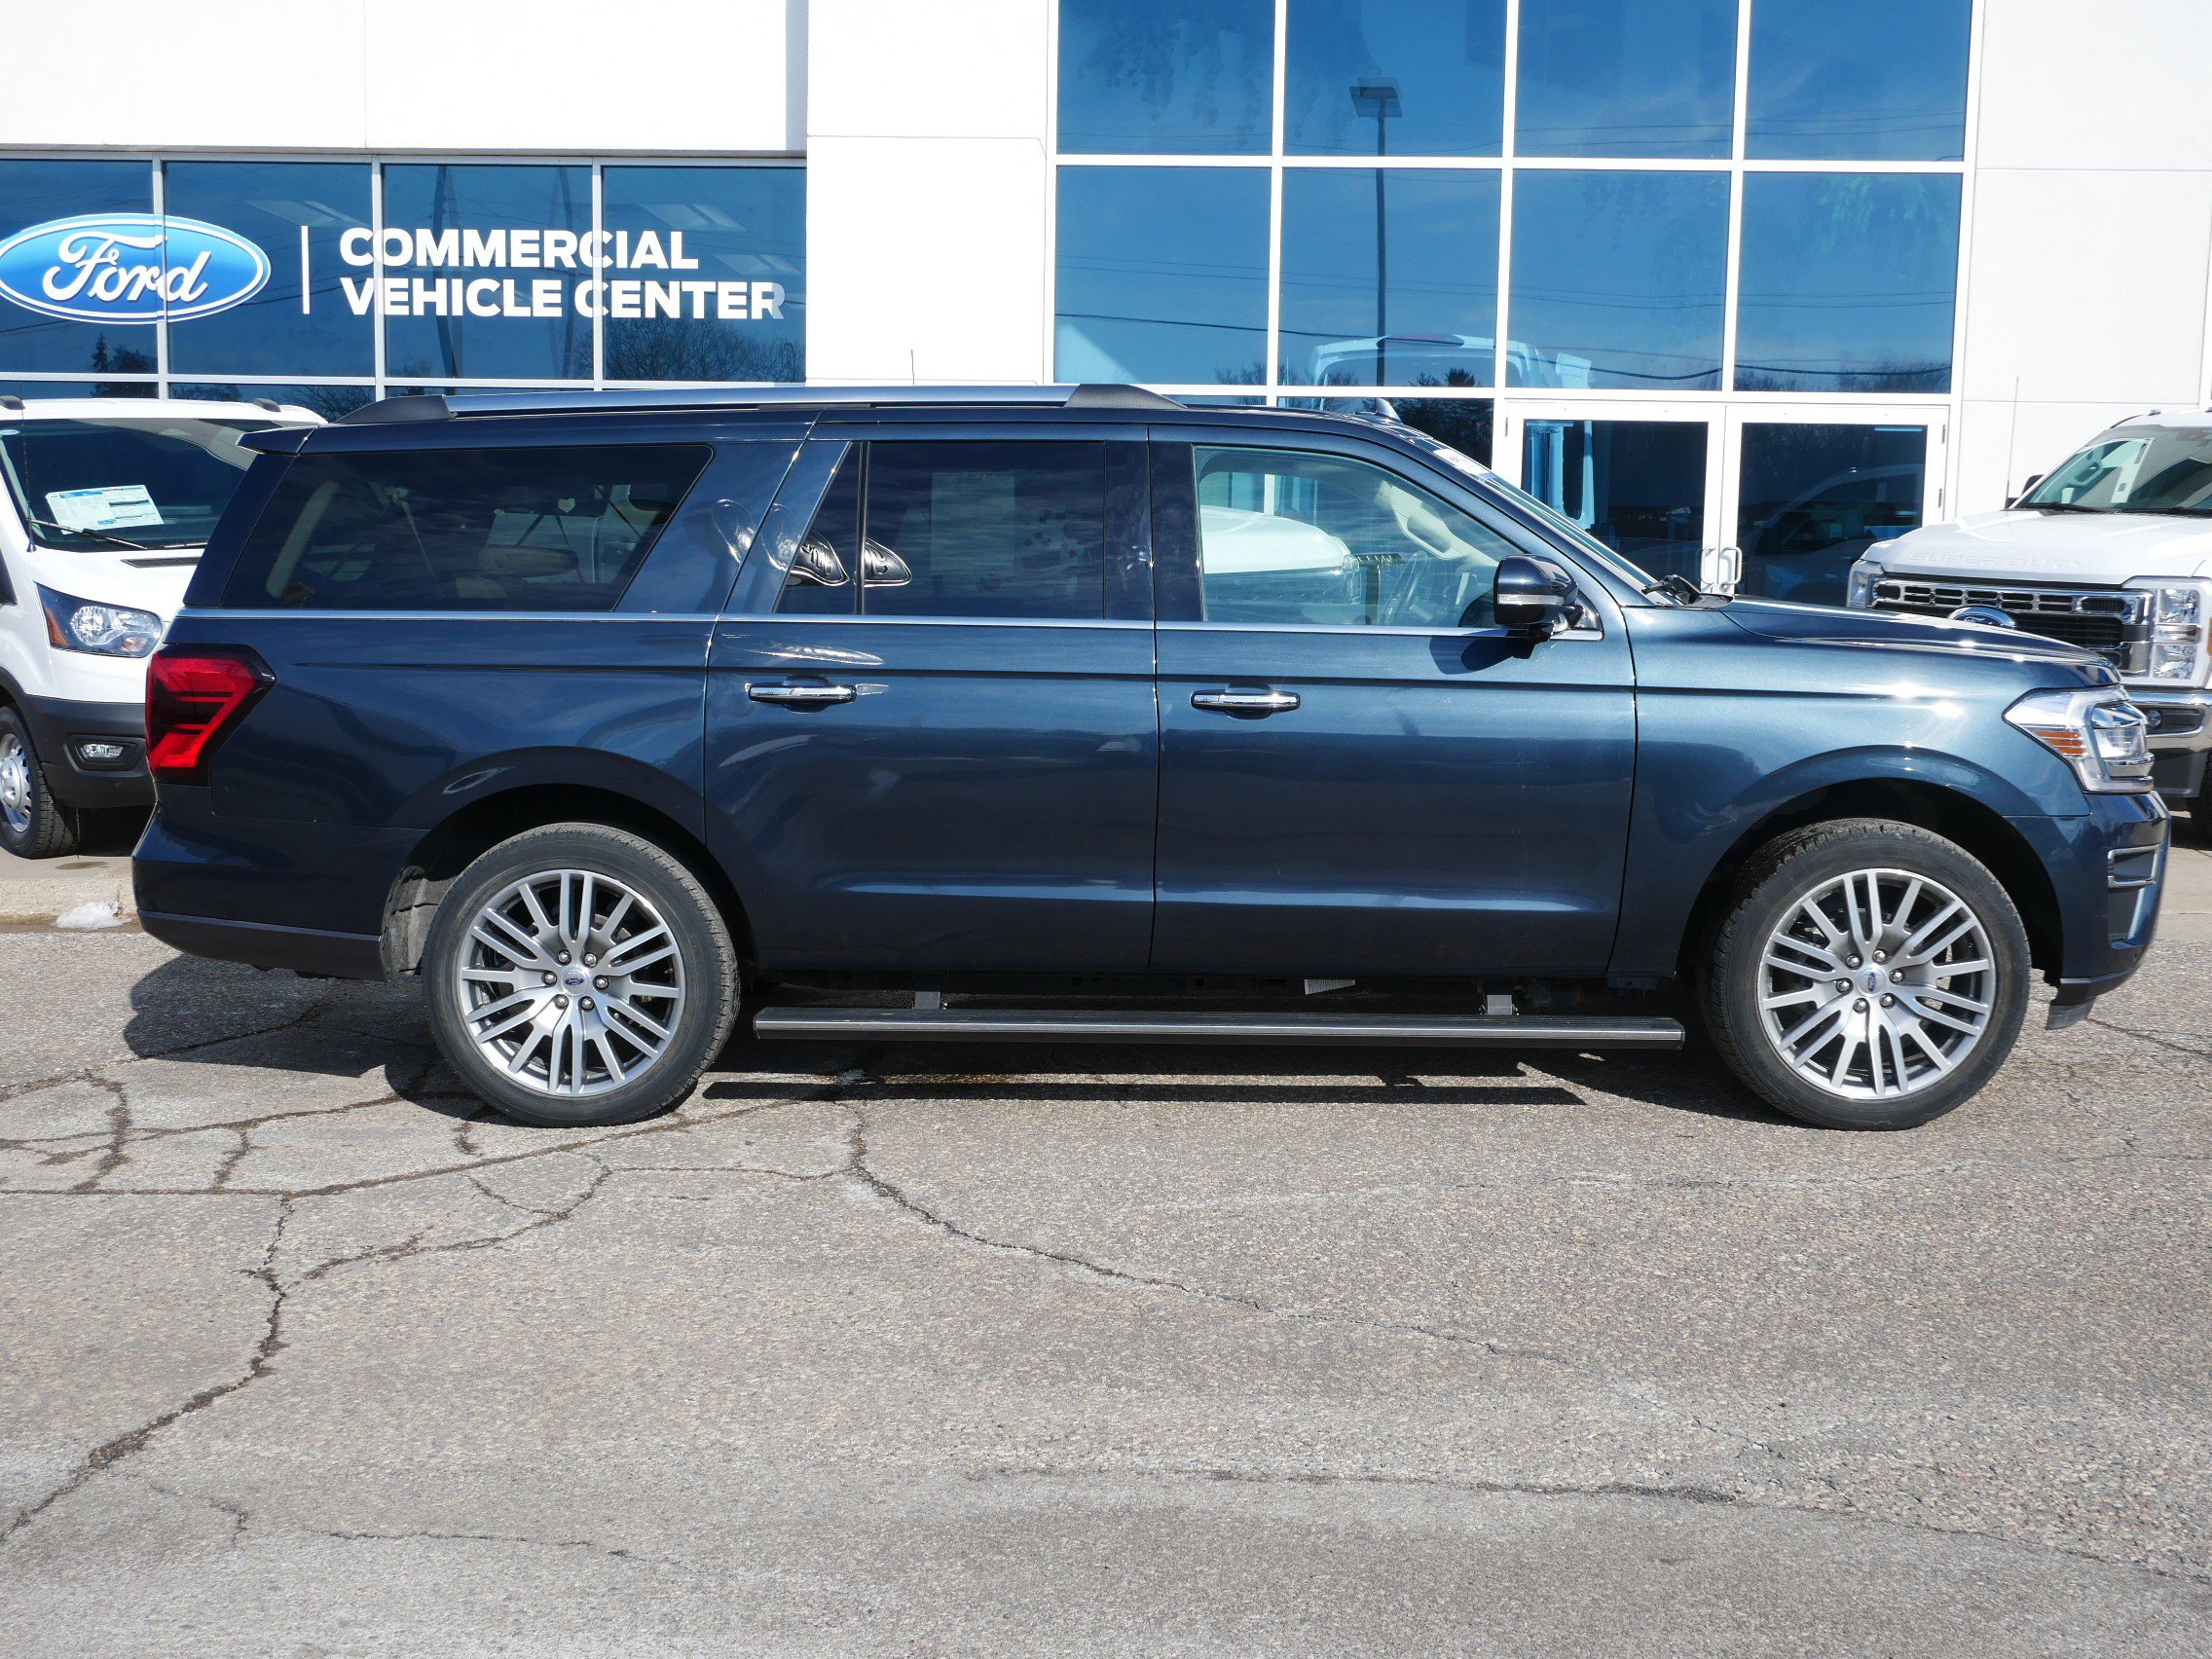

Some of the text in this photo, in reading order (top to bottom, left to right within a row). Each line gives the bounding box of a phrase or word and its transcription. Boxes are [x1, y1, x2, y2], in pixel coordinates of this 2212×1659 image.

[42, 231, 211, 302] Ford
[340, 227, 699, 270] COMMERCIAL
[340, 276, 785, 319] VEHICLE CENTER
[1909, 551, 2085, 570] SUPER DUTY
